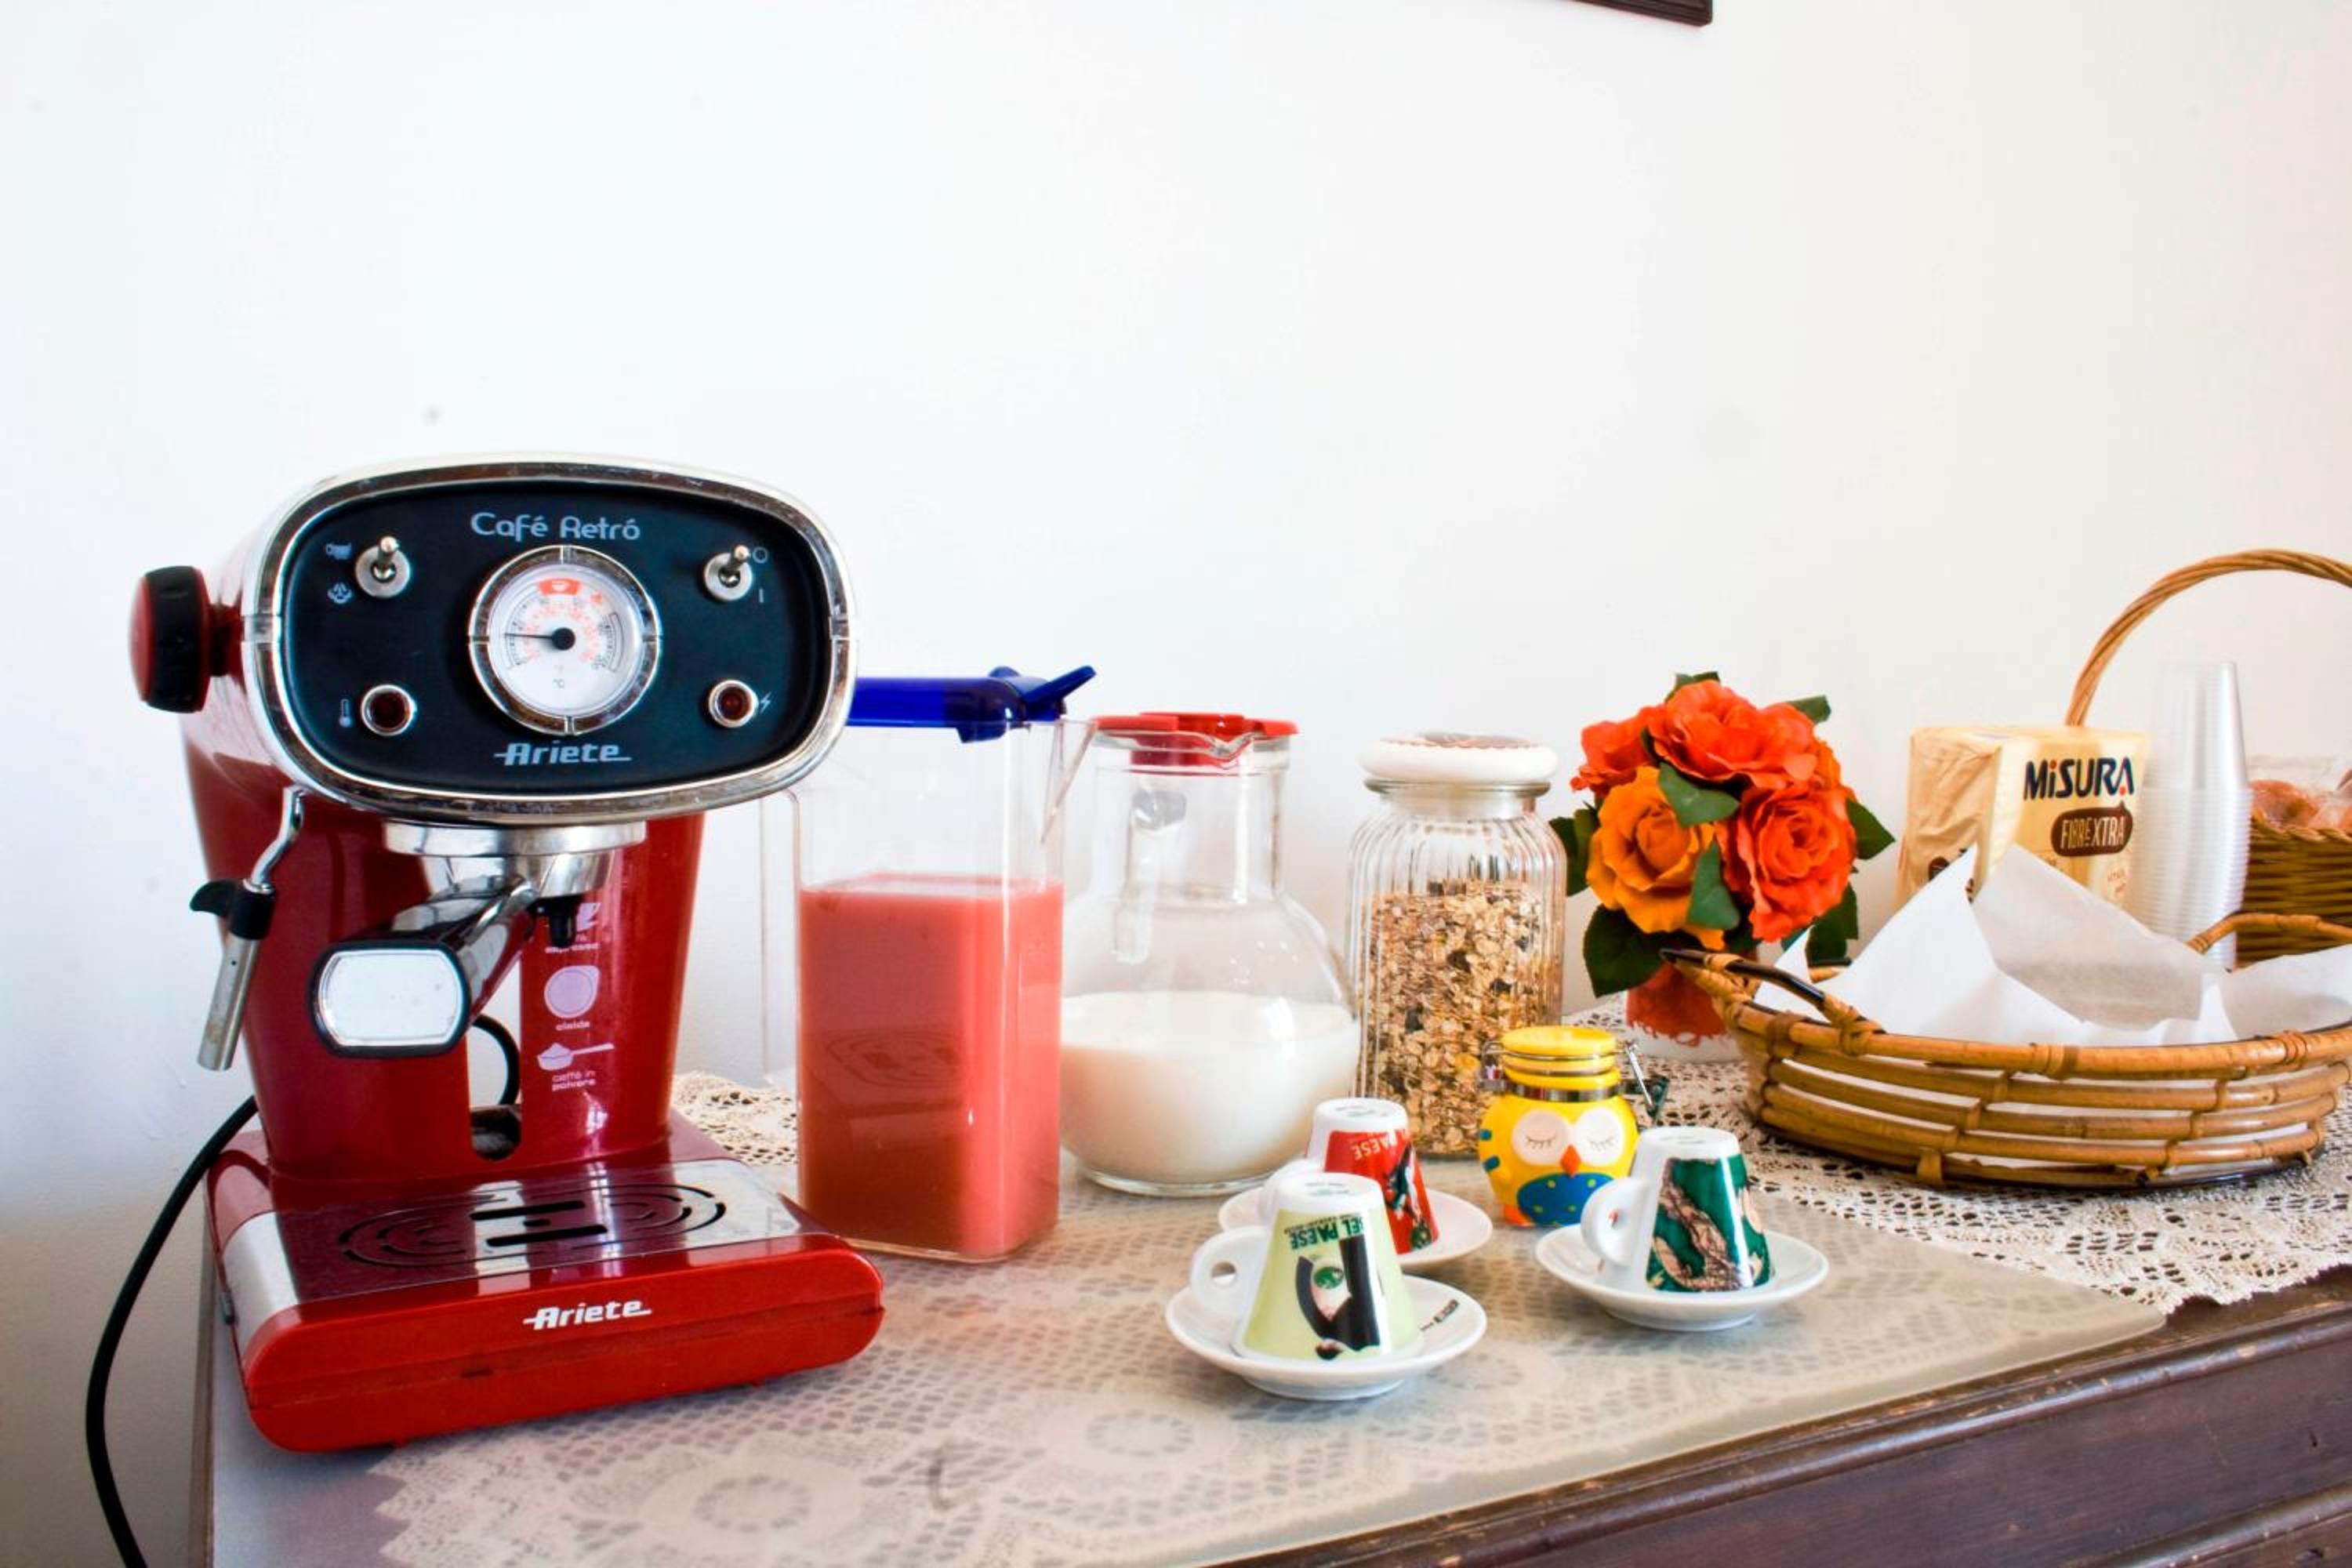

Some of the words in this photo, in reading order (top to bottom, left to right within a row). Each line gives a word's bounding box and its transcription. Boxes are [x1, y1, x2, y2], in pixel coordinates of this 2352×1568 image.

[470, 511, 549, 542] Café
[560, 514, 641, 540] Retró
[494, 740, 632, 766] Ariete
[1289, 1221, 1339, 1251] PAESE
[522, 1298, 653, 1330] Ariete
